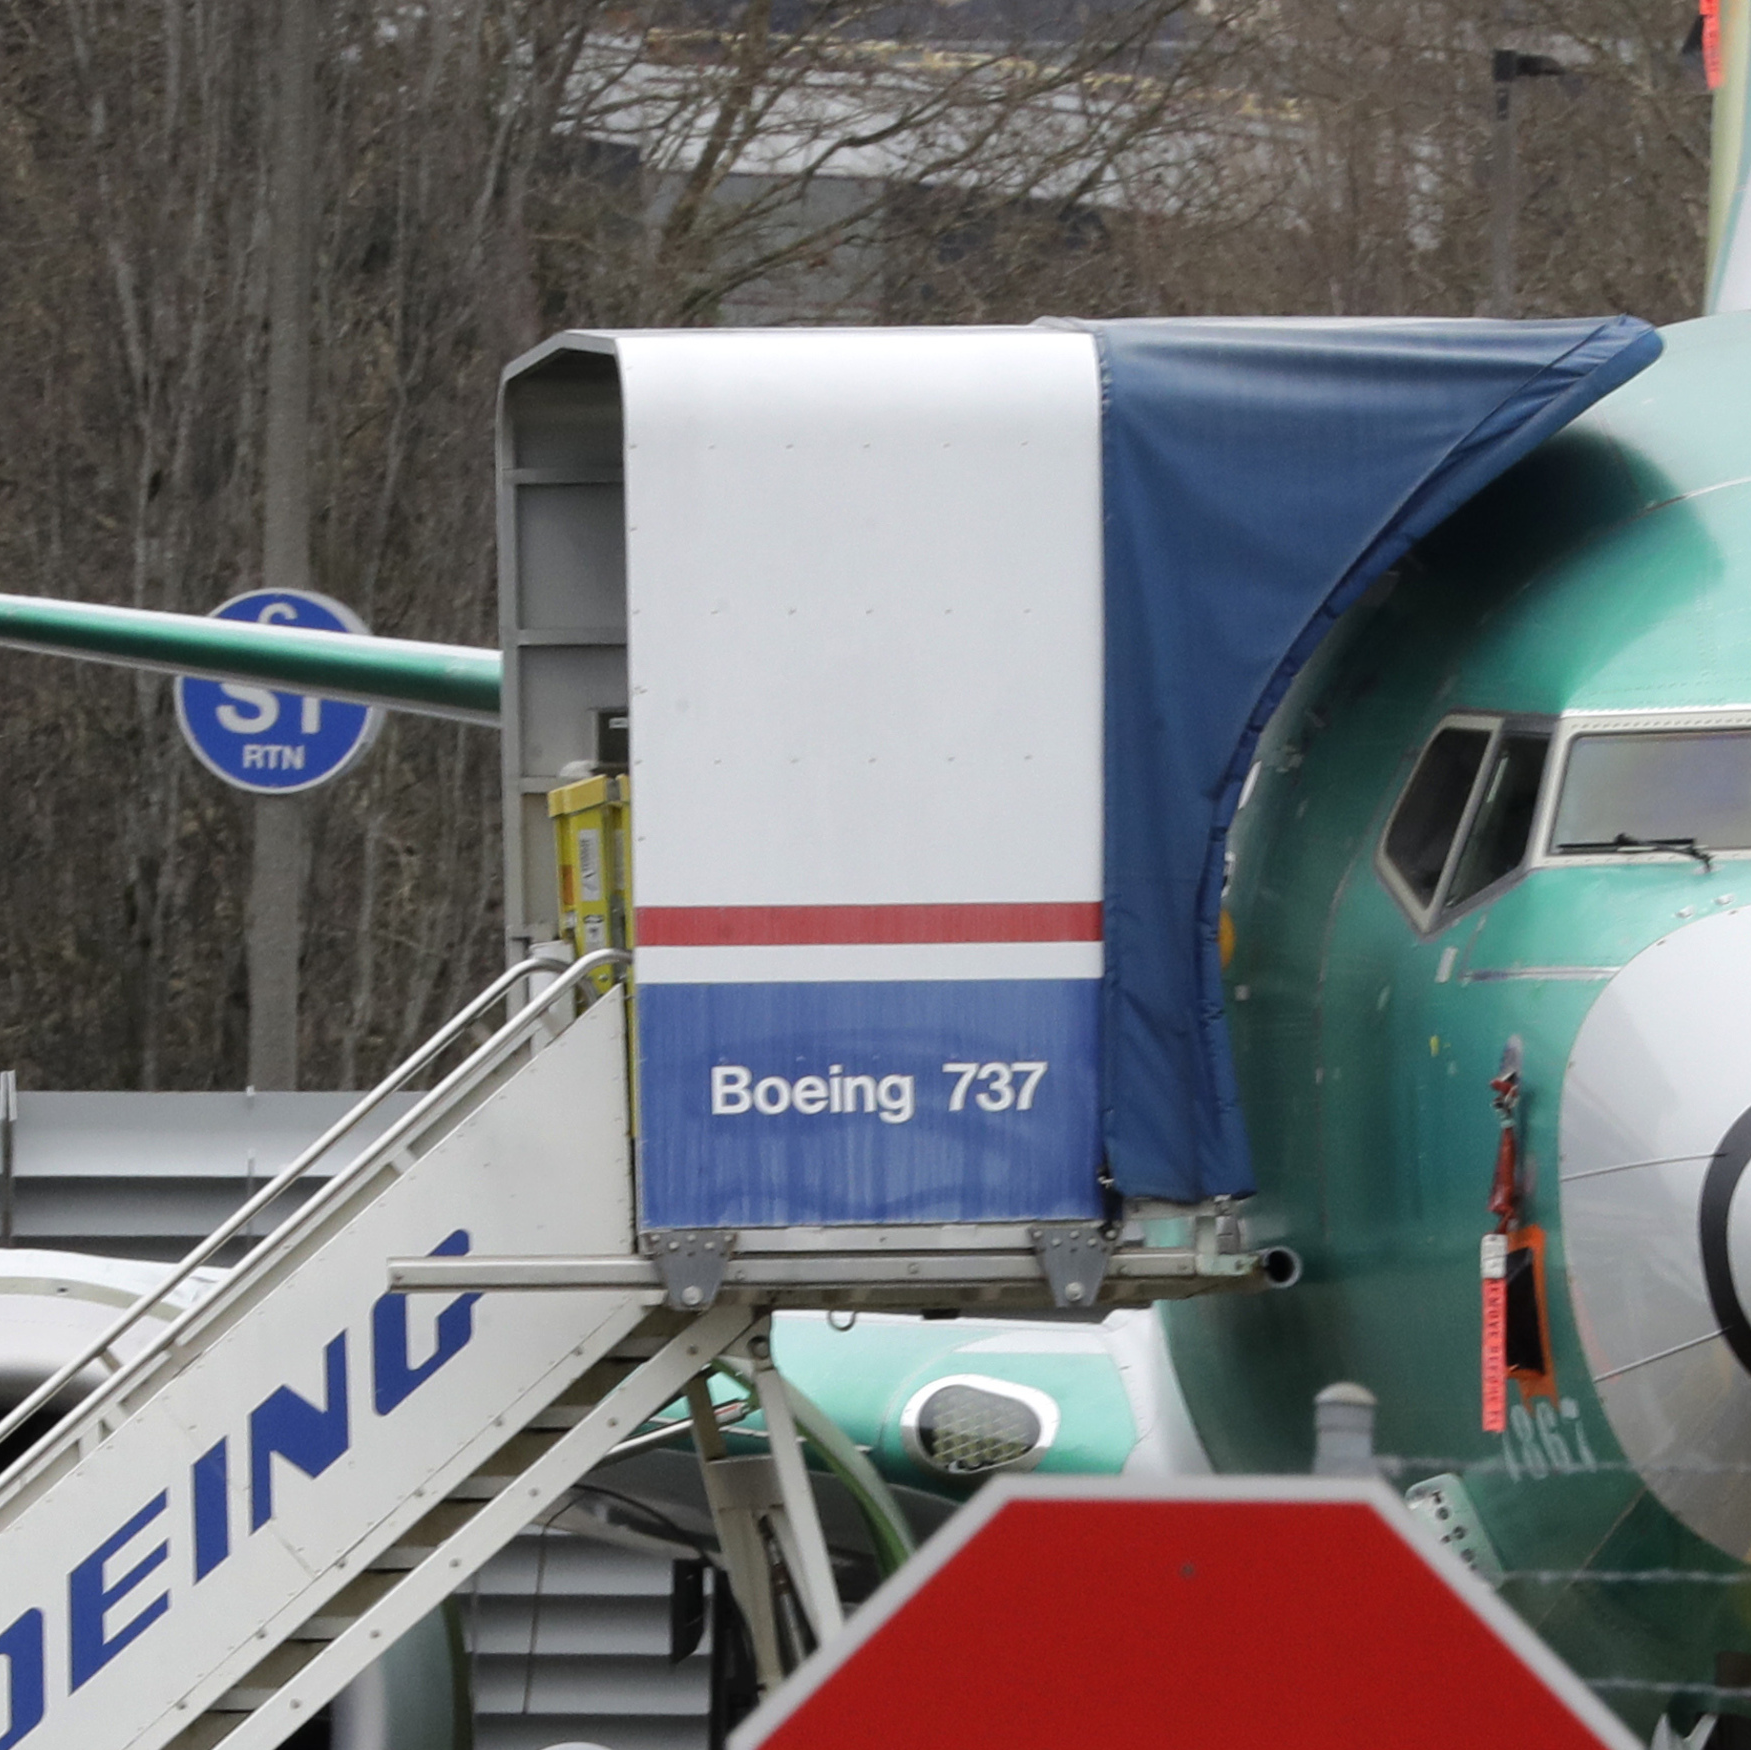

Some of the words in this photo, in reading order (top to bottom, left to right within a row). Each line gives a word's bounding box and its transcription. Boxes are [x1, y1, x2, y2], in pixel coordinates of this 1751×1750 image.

[242, 744, 305, 770] RTN
[710, 1064, 916, 1124] Boeing
[942, 1061, 1049, 1113] 737
